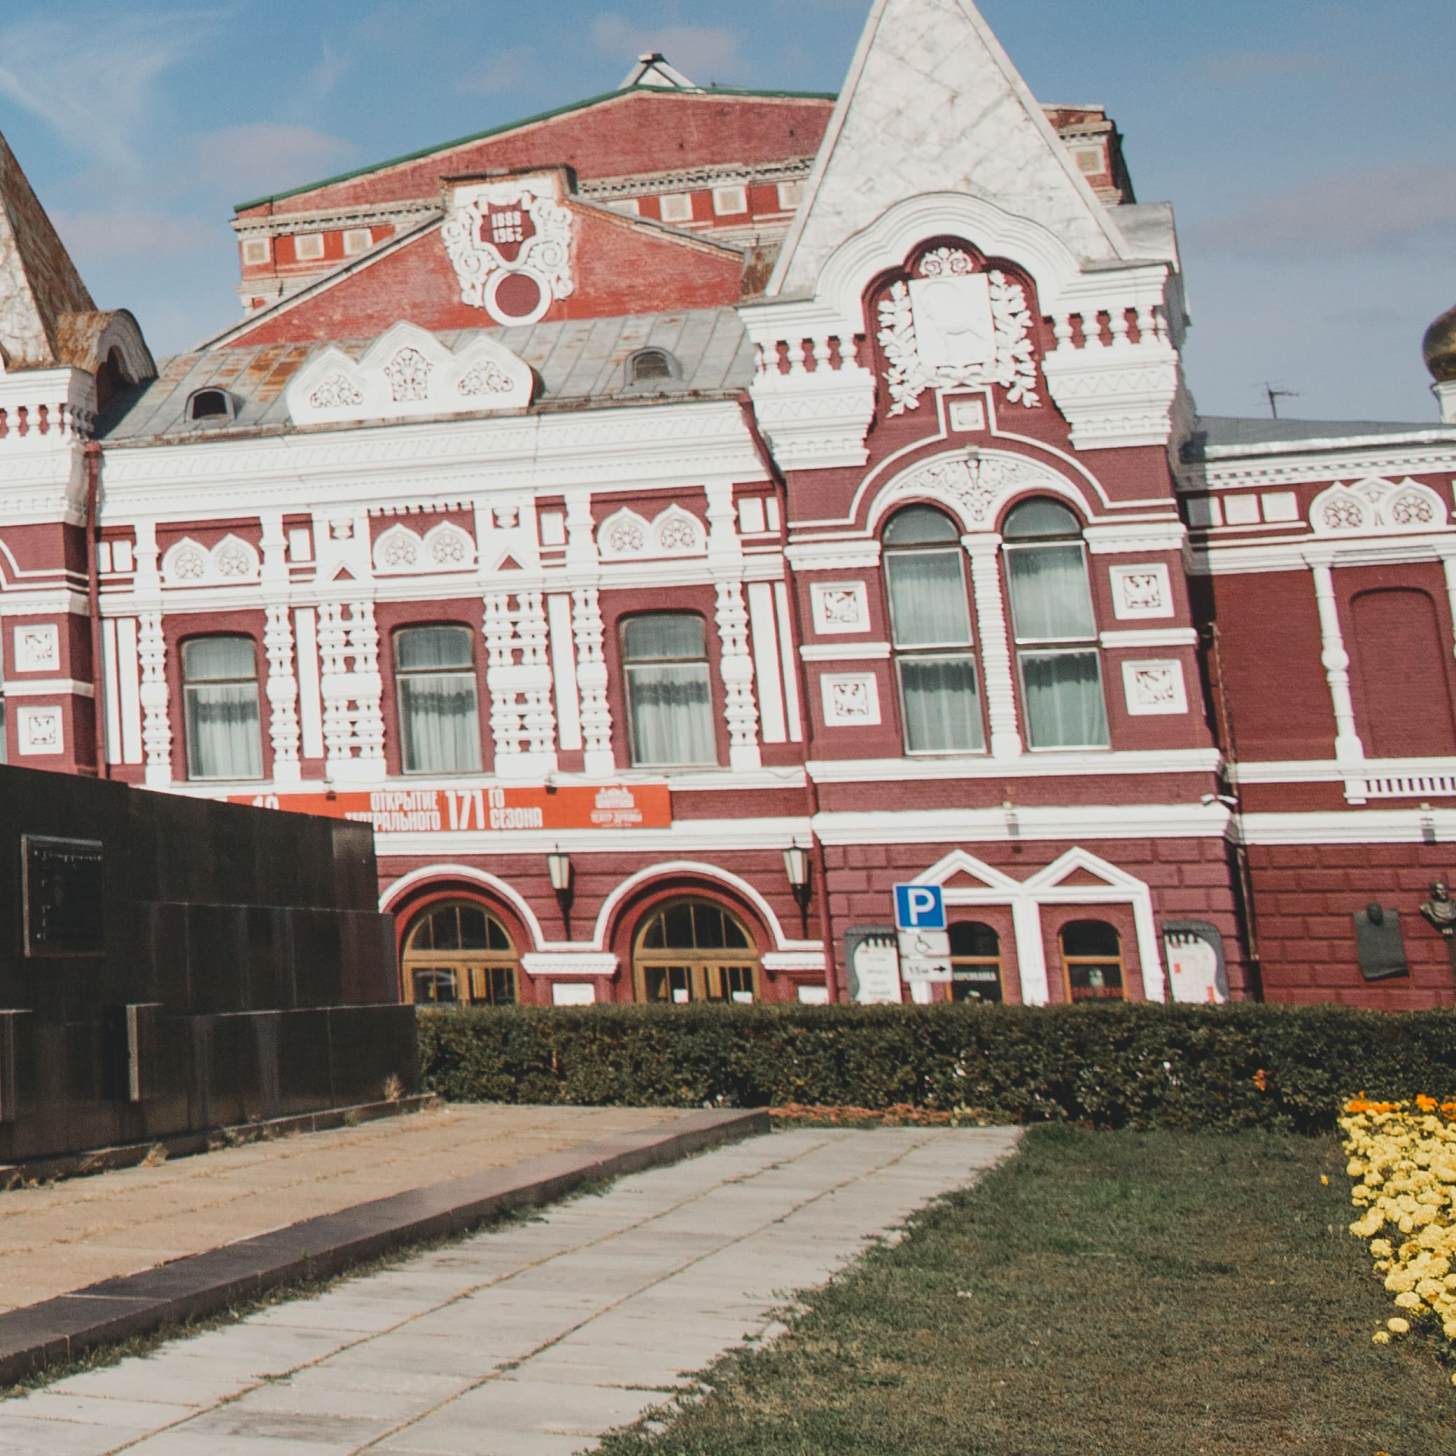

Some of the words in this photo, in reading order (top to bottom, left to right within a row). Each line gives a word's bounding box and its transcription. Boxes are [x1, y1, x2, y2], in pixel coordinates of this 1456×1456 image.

[370, 791, 439, 811] ОТКРЫТИЕ
[445, 789, 485, 830] 171
[488, 789, 505, 808] ГО
[490, 807, 543, 829] СЕЗОНА
[907, 888, 936, 926] P
